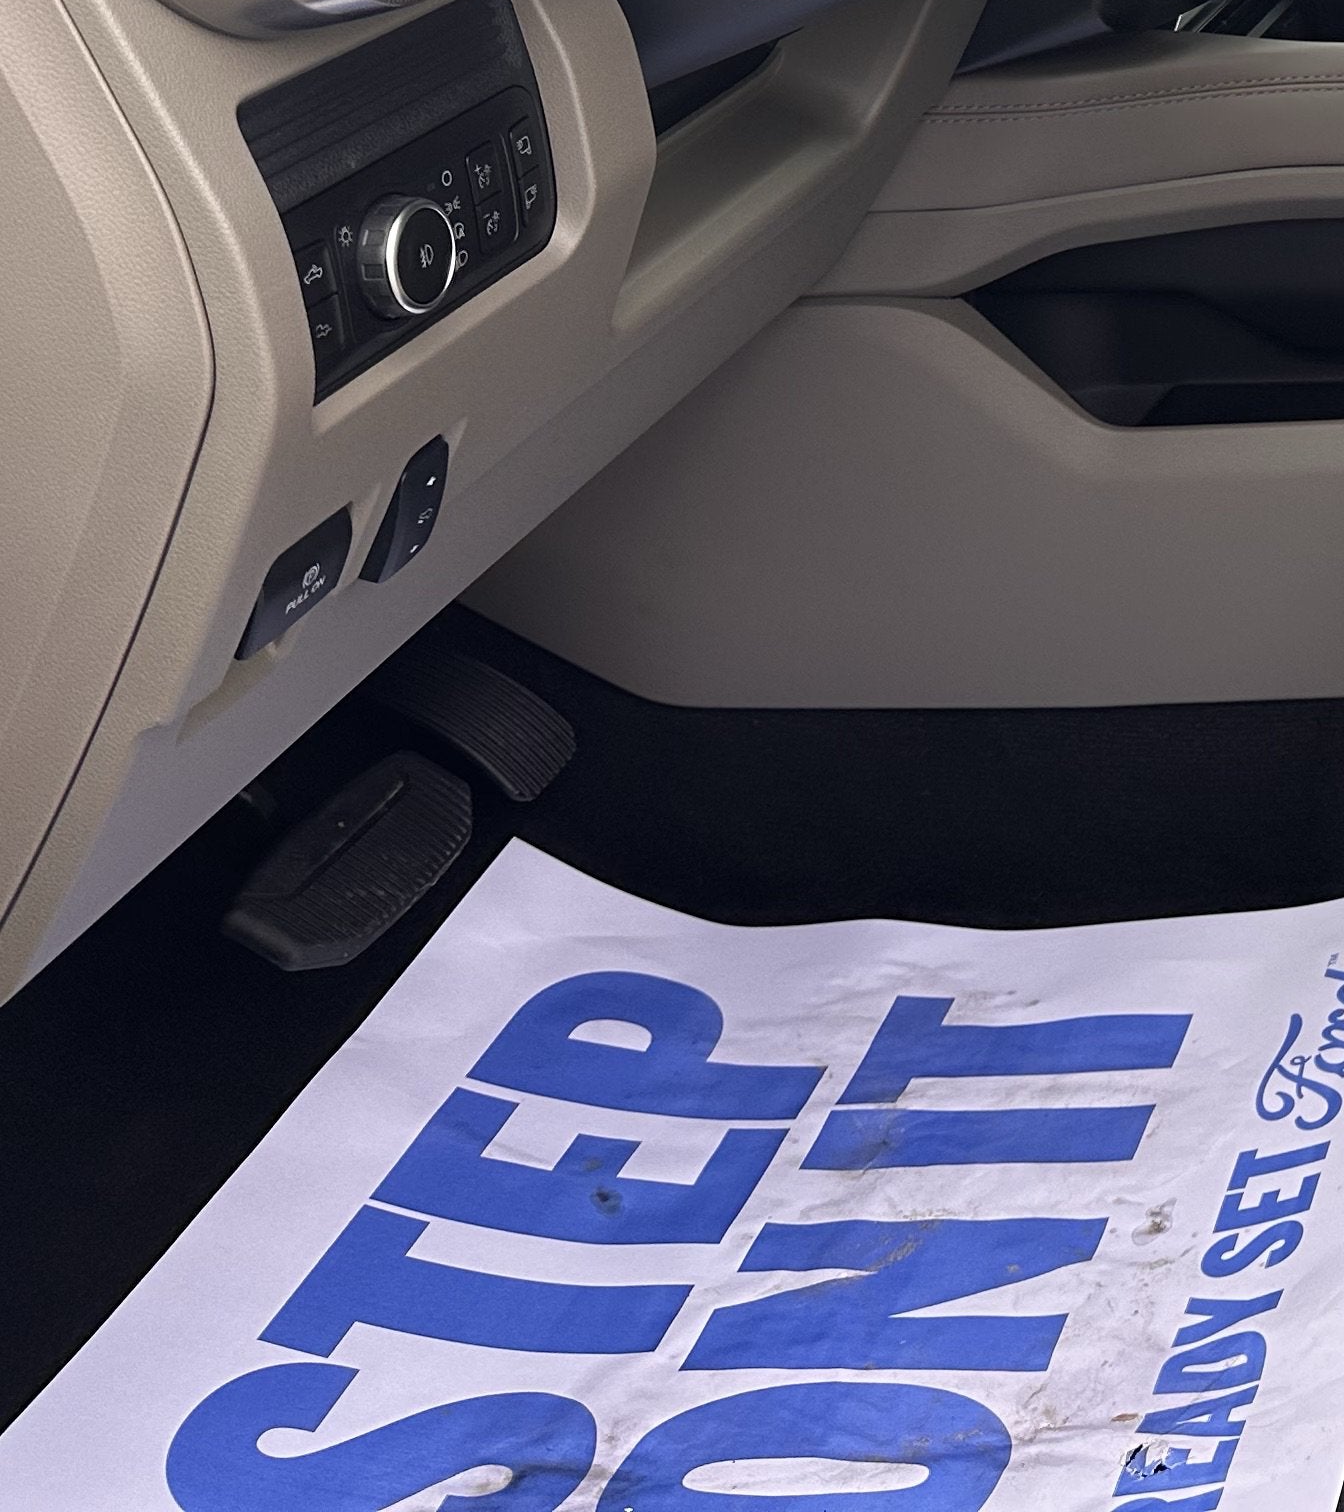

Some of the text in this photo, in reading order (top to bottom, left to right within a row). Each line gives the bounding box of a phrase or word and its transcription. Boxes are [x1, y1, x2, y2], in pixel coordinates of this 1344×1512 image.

[285, 575, 327, 615] PULL ON
[165, 968, 829, 1512] STEP
[598, 994, 1193, 1512] ON IT
[1200, 1139, 1332, 1279] SET
